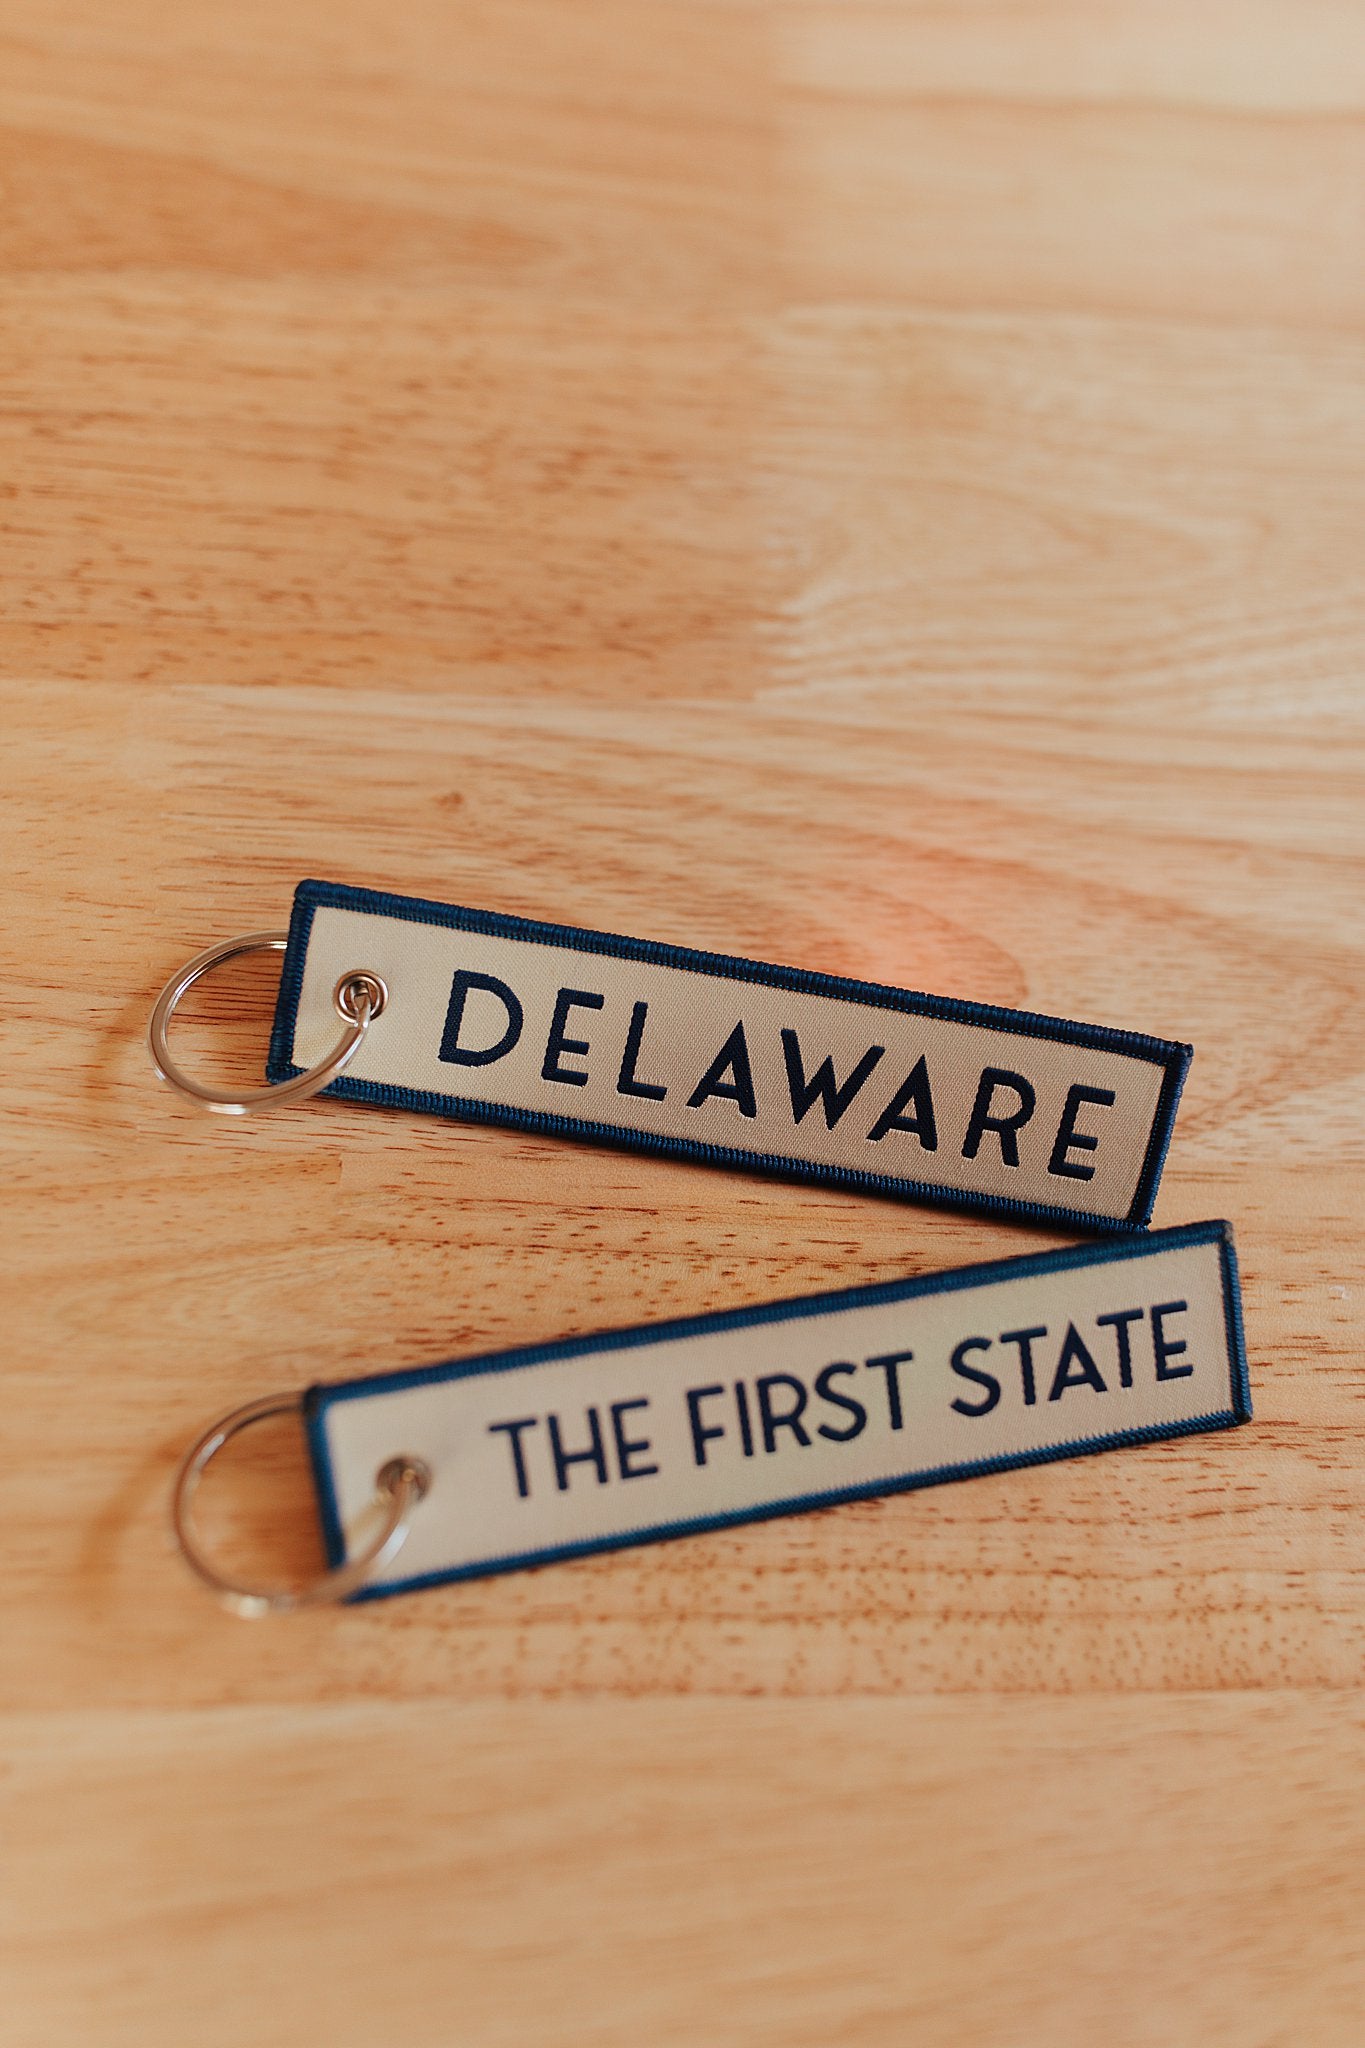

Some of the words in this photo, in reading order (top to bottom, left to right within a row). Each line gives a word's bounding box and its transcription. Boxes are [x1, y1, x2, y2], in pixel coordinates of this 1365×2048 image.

[437, 968, 1117, 1183] DELAWARE
[487, 1397, 661, 1499] THE
[684, 1350, 915, 1467] FIRST
[948, 1299, 1195, 1418] STATE
